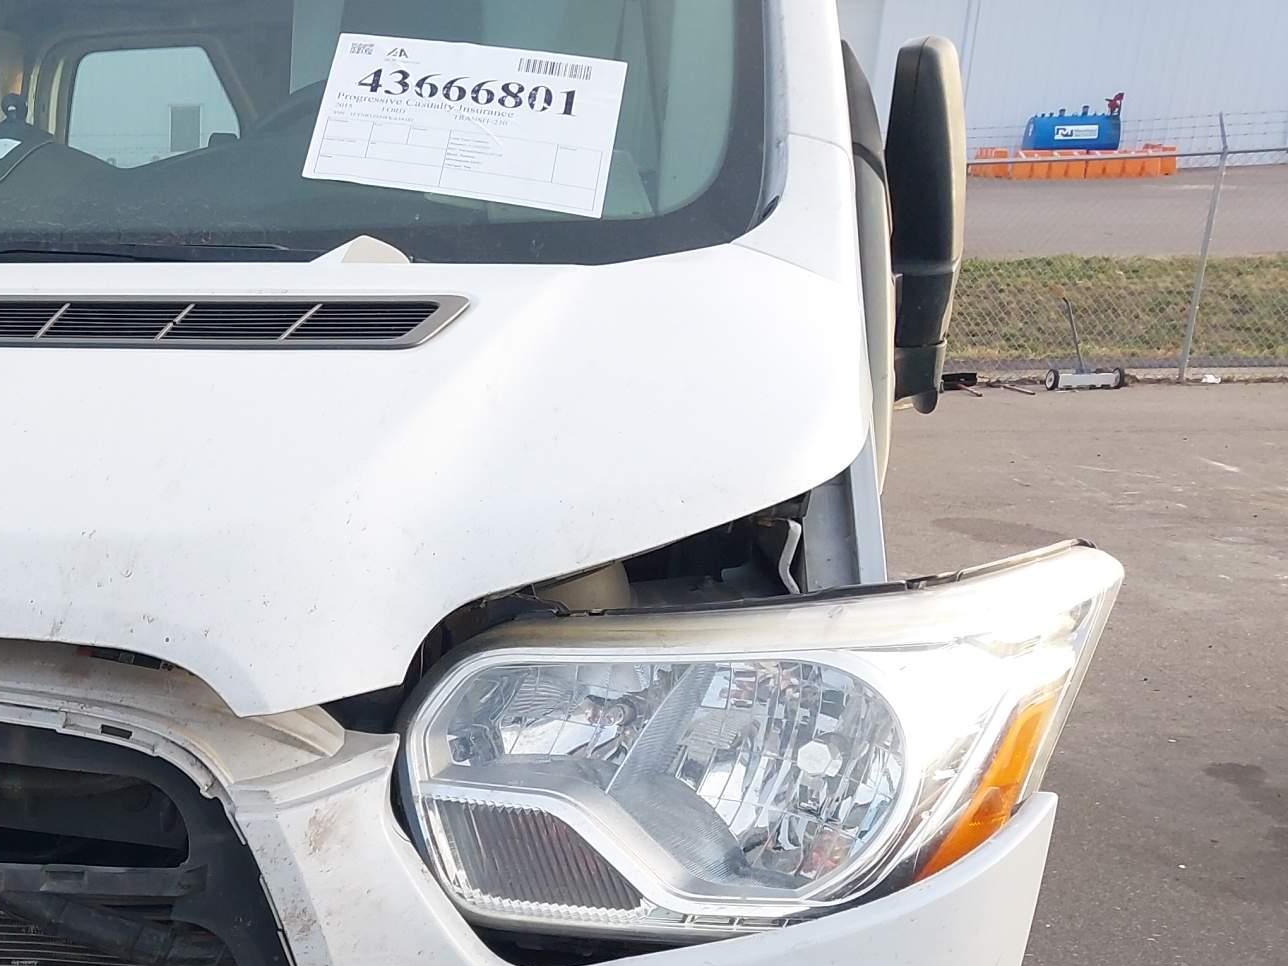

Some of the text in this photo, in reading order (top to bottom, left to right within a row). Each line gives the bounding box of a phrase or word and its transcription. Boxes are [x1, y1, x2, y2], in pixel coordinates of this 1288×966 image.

[337, 91, 515, 118] Progressive Casualty Insurance
[357, 67, 578, 117] 43666801
